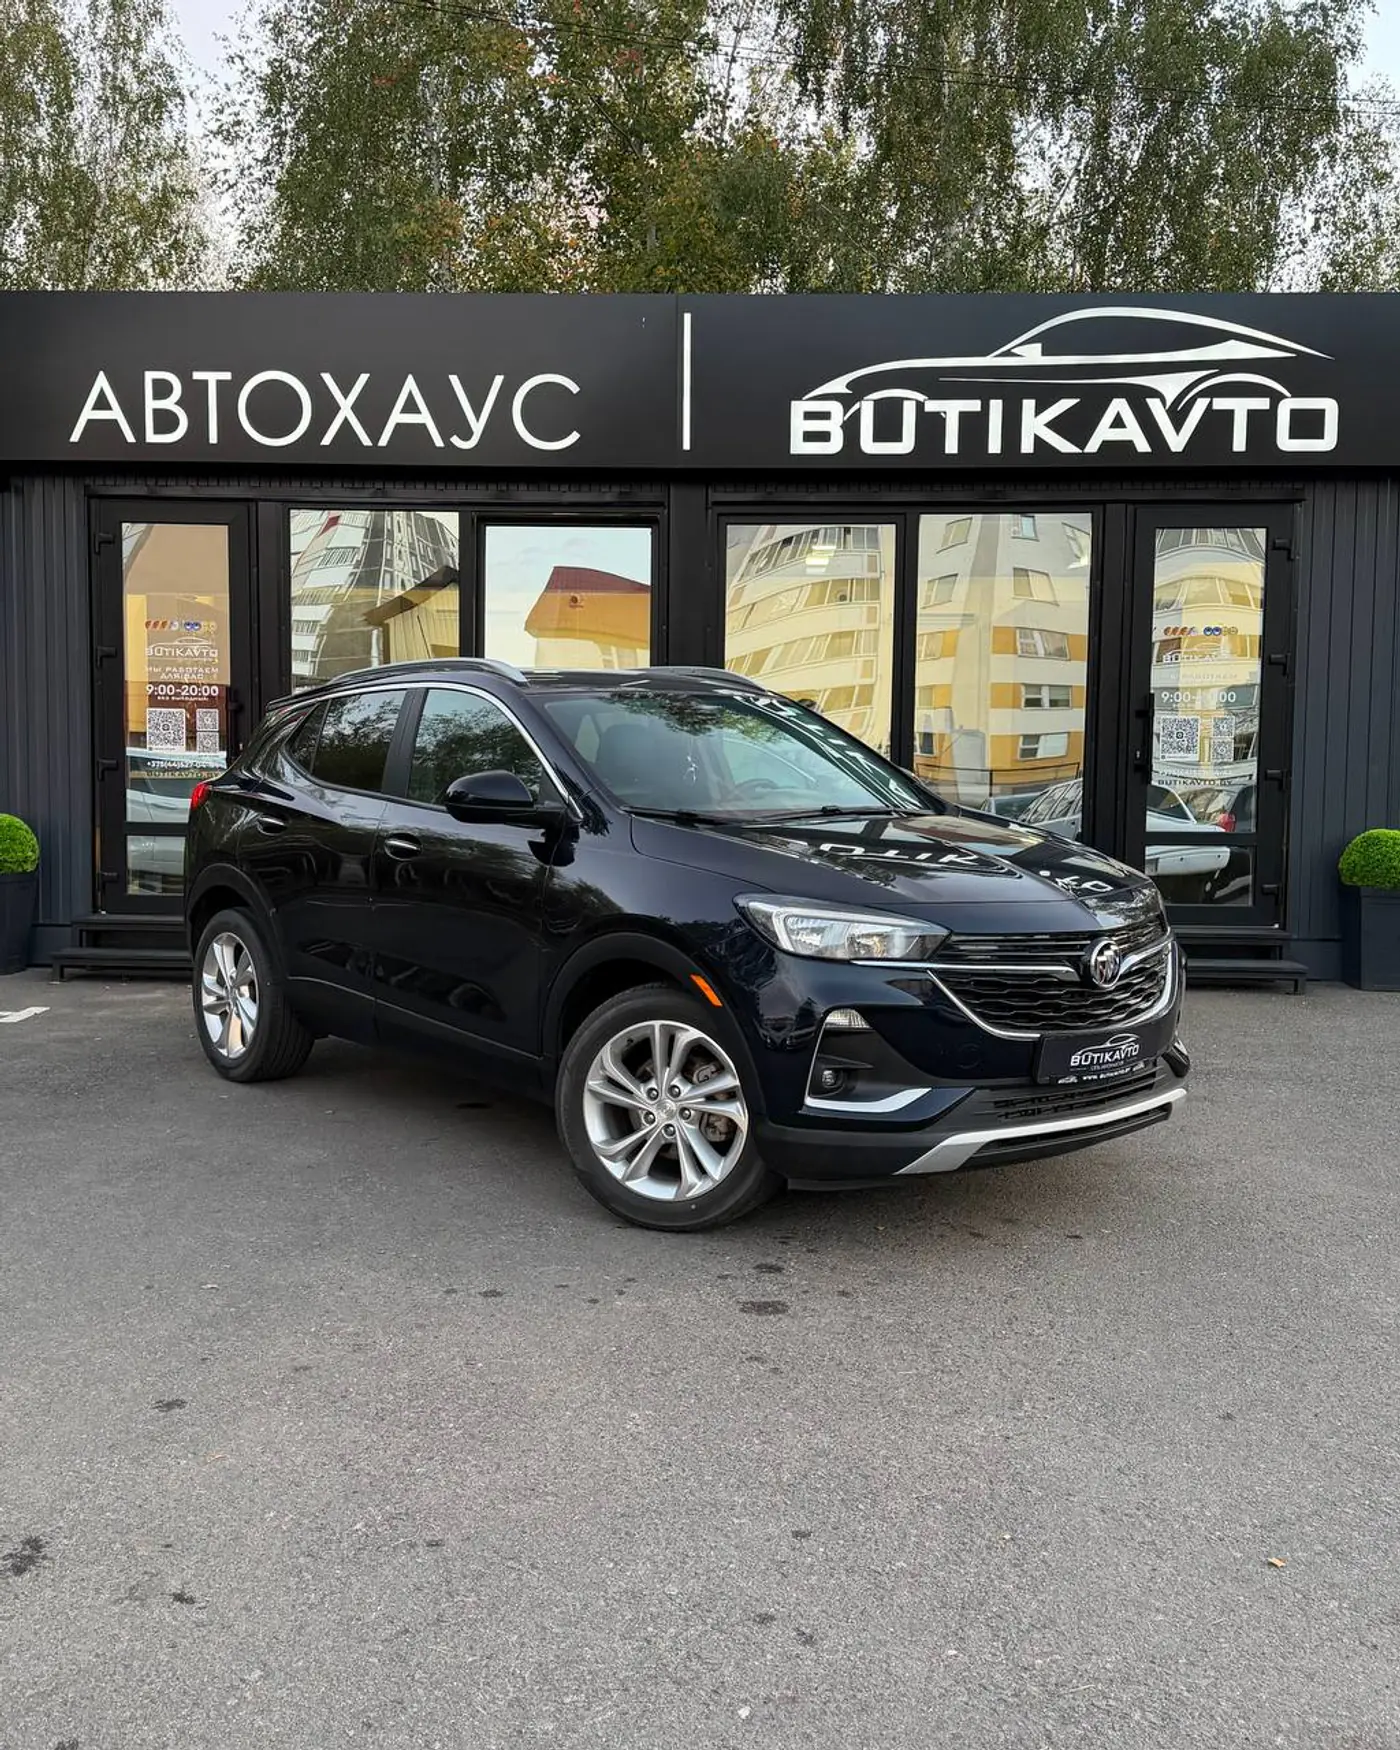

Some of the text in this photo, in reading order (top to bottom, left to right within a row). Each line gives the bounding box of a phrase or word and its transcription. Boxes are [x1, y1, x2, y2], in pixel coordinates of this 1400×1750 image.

[69, 370, 581, 451] АВТОХАУС
[790, 396, 1339, 455] BUTIKAVTO
[147, 684, 219, 696] 9:00-20:00
[1070, 1044, 1140, 1067] BUTIKAVTO
